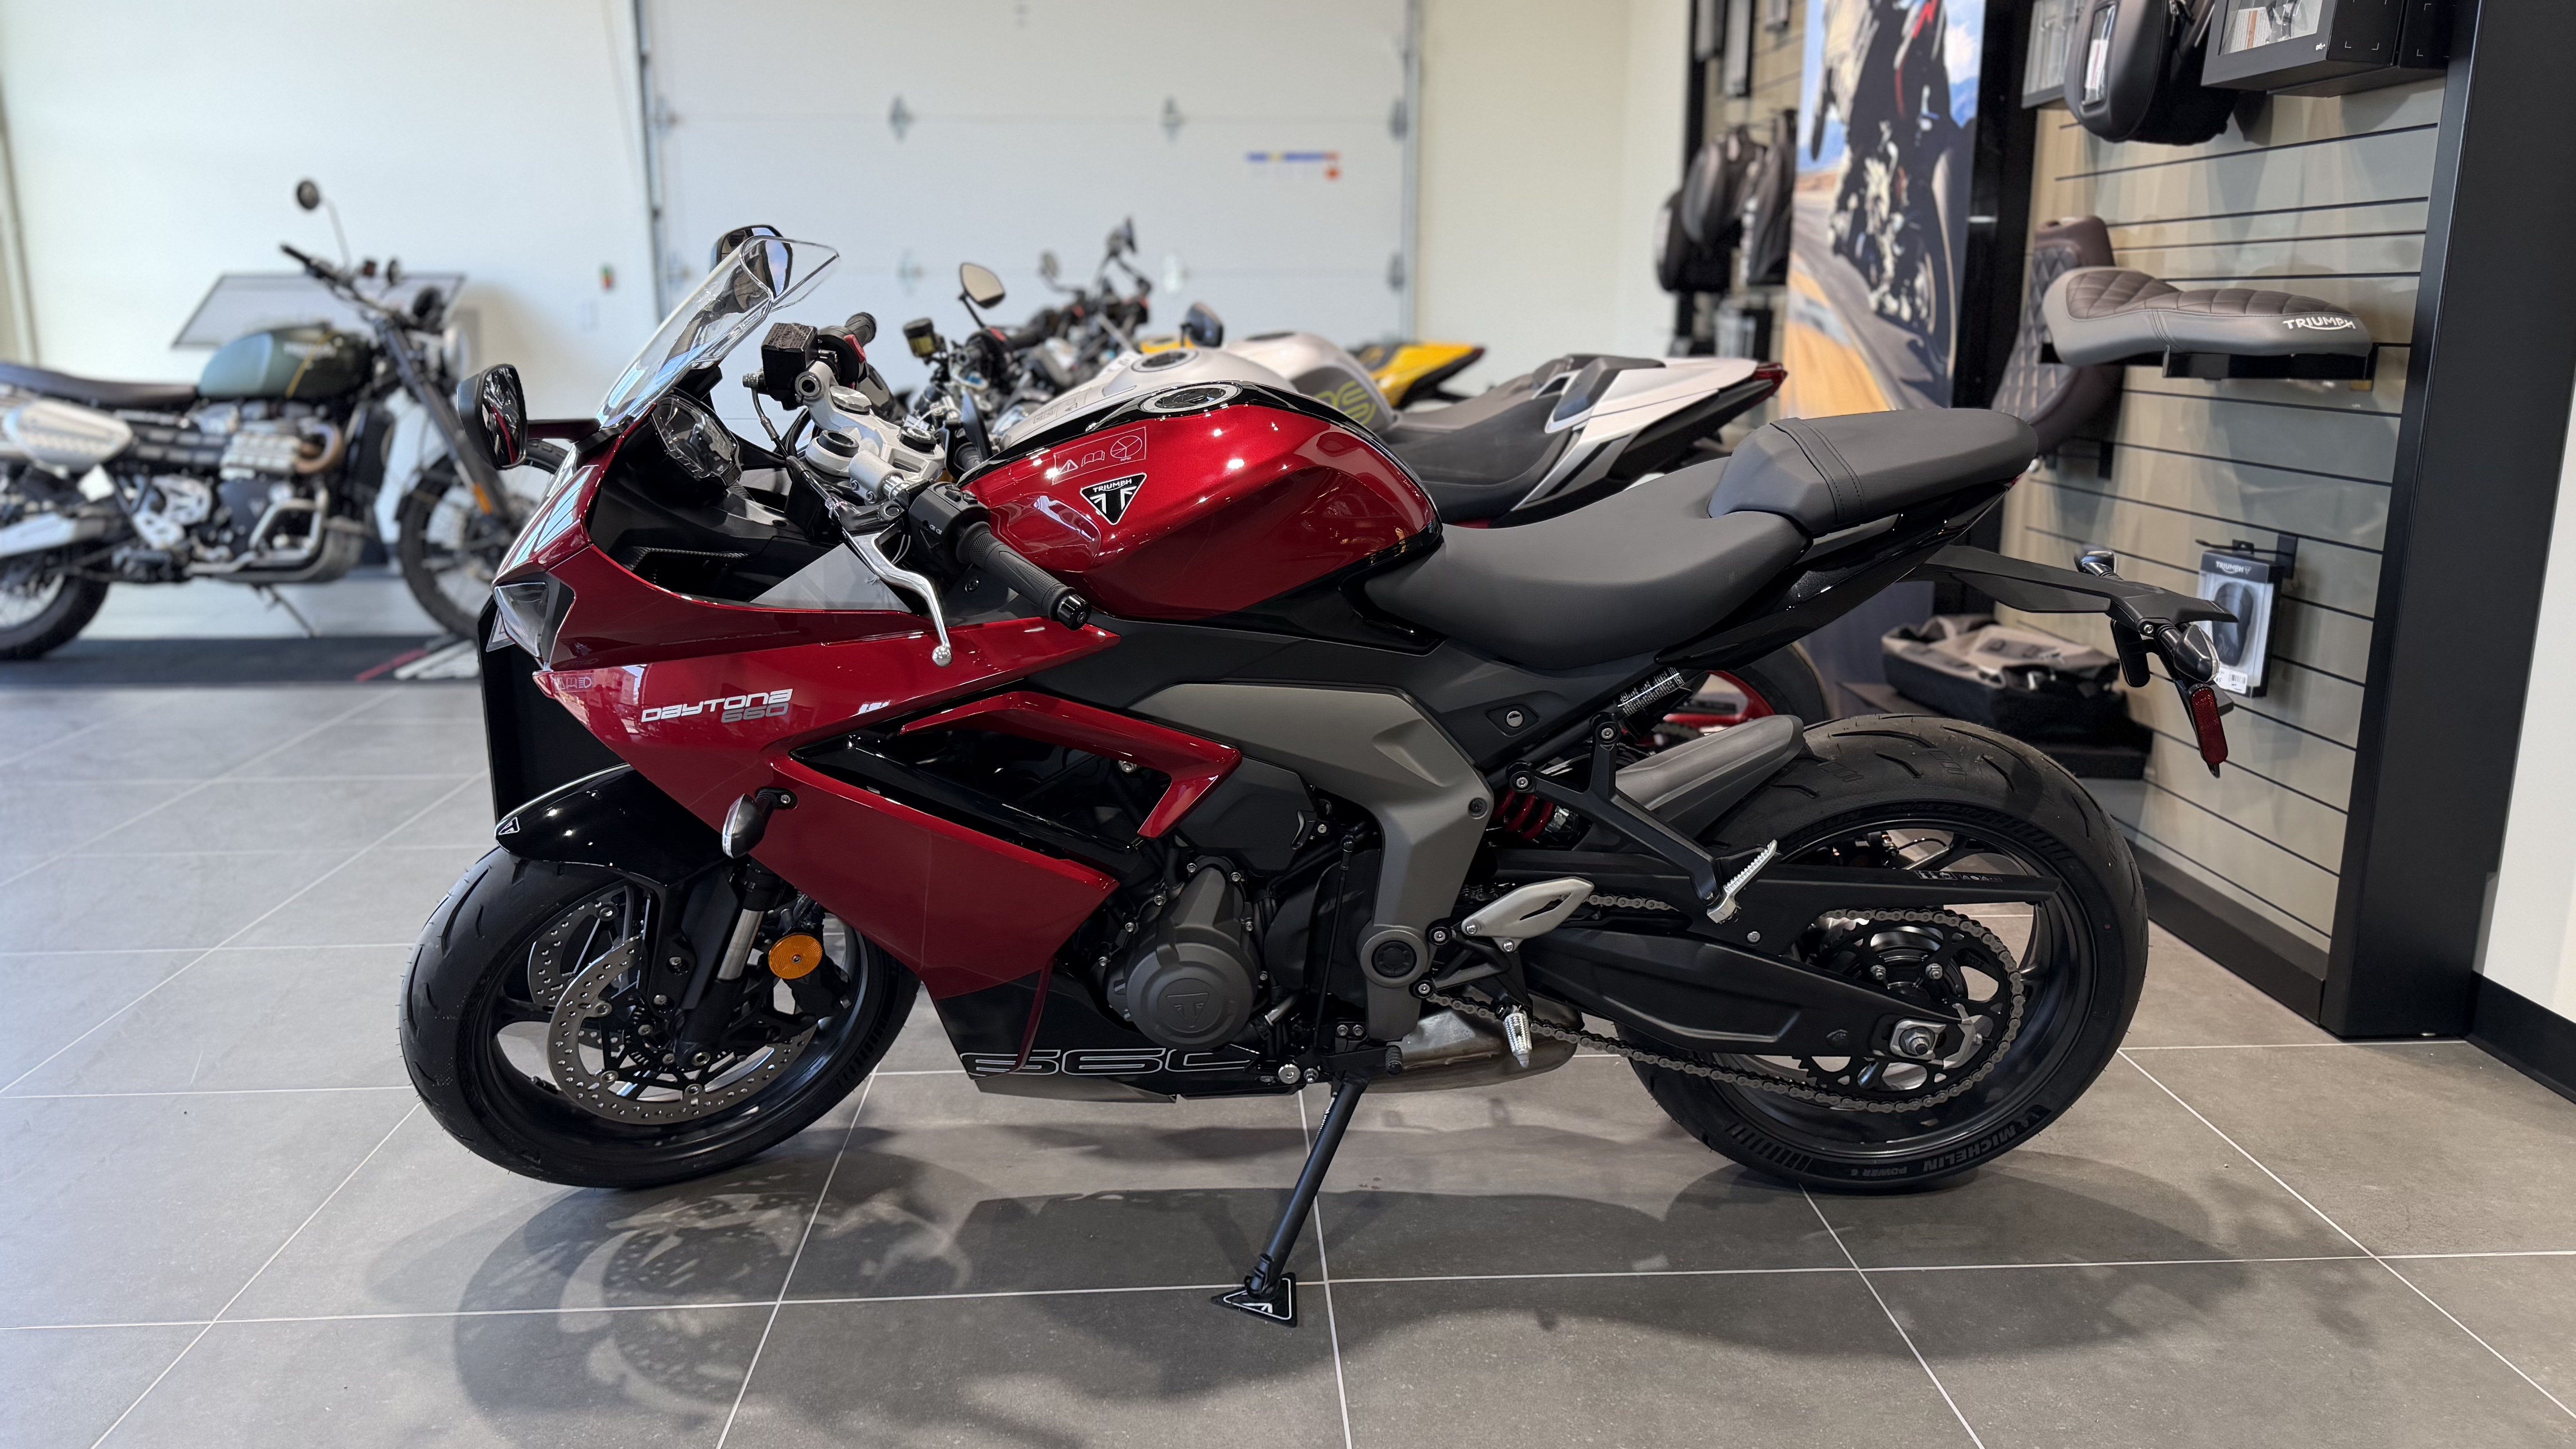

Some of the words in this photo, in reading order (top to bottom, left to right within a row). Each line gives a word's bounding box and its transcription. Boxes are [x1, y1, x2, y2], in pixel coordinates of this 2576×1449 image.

[2282, 317, 2356, 330] TRIUMPH
[1093, 478, 1132, 492] TRIUMPH
[2216, 561, 2244, 574] TRIUMPH
[721, 702, 789, 723] 660
[1922, 1125, 2016, 1172] MICHELIN
[1862, 1166, 1908, 1177] POWER
